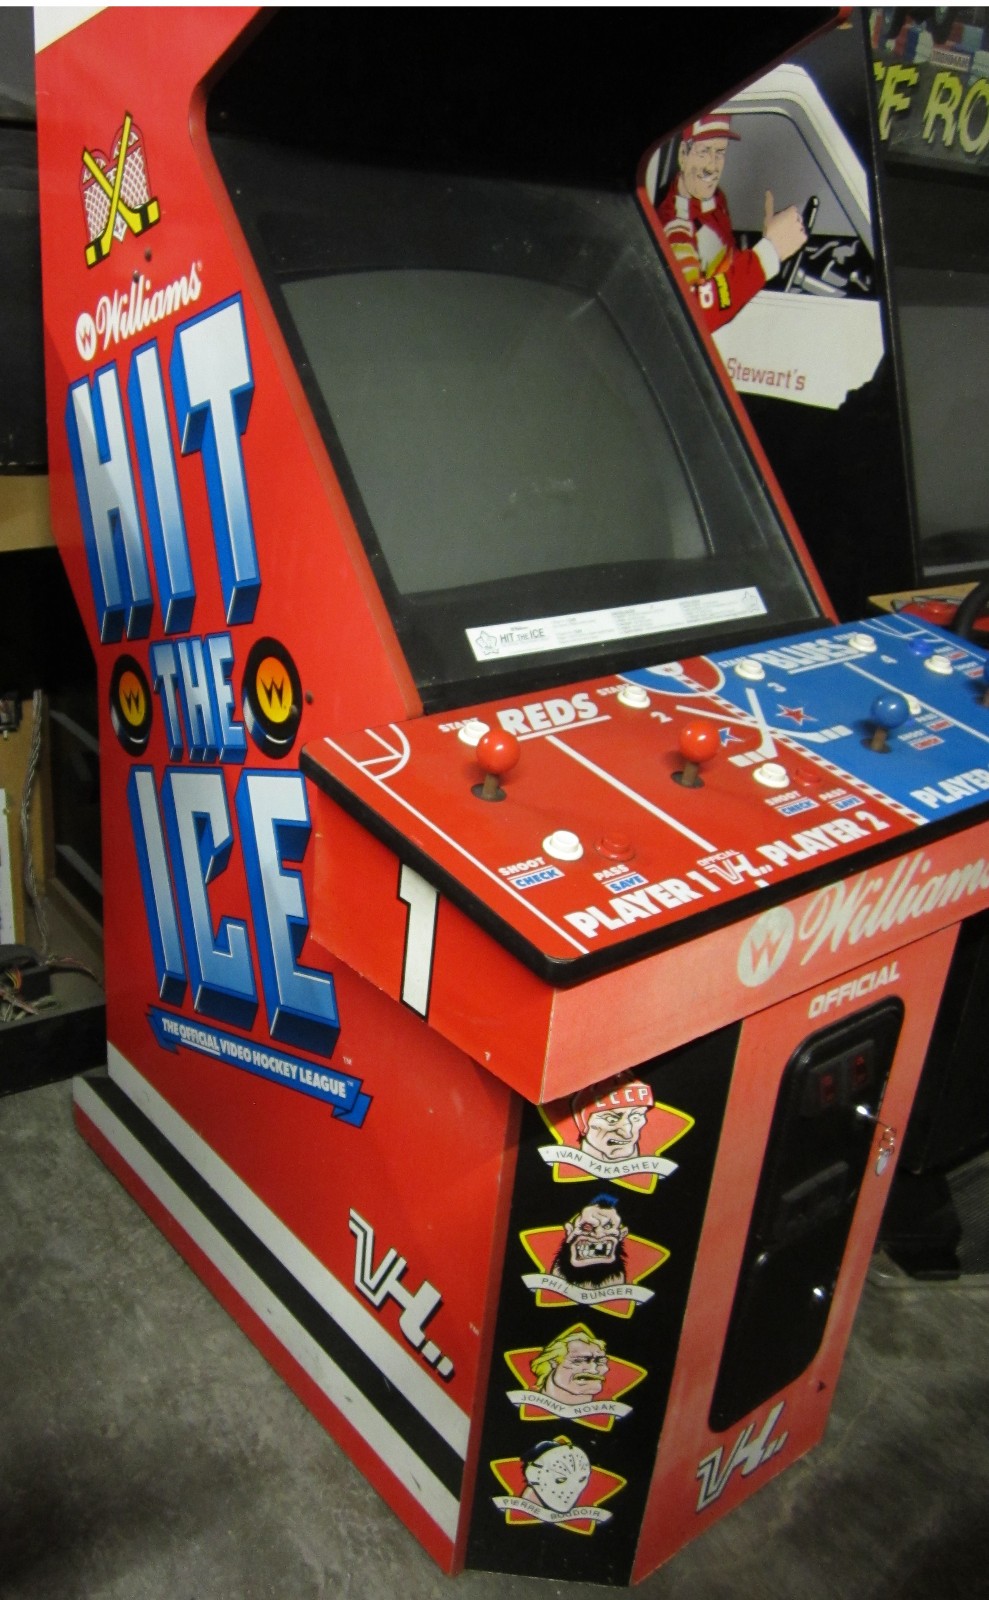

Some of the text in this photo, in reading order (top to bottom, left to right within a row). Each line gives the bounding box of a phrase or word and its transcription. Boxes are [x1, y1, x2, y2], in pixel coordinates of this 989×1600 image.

[96, 266, 201, 351] Williams
[726, 357, 806, 391] Stewart's
[65, 290, 261, 642] HIT
[500, 633, 515, 644] HIT
[530, 627, 545, 640] ICE
[148, 631, 248, 765] THE
[496, 692, 599, 736] REDS
[651, 711, 673, 724] 2
[781, 800, 815, 815] CHECK
[756, 810, 891, 867] PLAYER 2
[498, 856, 547, 877] SHOOT
[696, 849, 740, 866] OFFICIAL
[513, 868, 560, 888] CHECK
[593, 864, 630, 881] PASS
[608, 874, 645, 892] SAVE
[126, 764, 342, 1059] ICE
[563, 870, 721, 938] PLAYER 1
[808, 960, 900, 1019] OFFICIAL
[161, 1017, 180, 1037] THE
[180, 1025, 220, 1054] OFFICIAL
[219, 1038, 252, 1063] VIDEO
[252, 1050, 298, 1080] HOCKEY
[299, 1067, 347, 1099] LEAGUE
[555, 1150, 661, 1176] IVAN YAKASHEV
[541, 1277, 634, 1301] PHIL BUNGER
[520, 1393, 617, 1416] JOHNNY NOVAK
[502, 1498, 541, 1515] PIERRE
